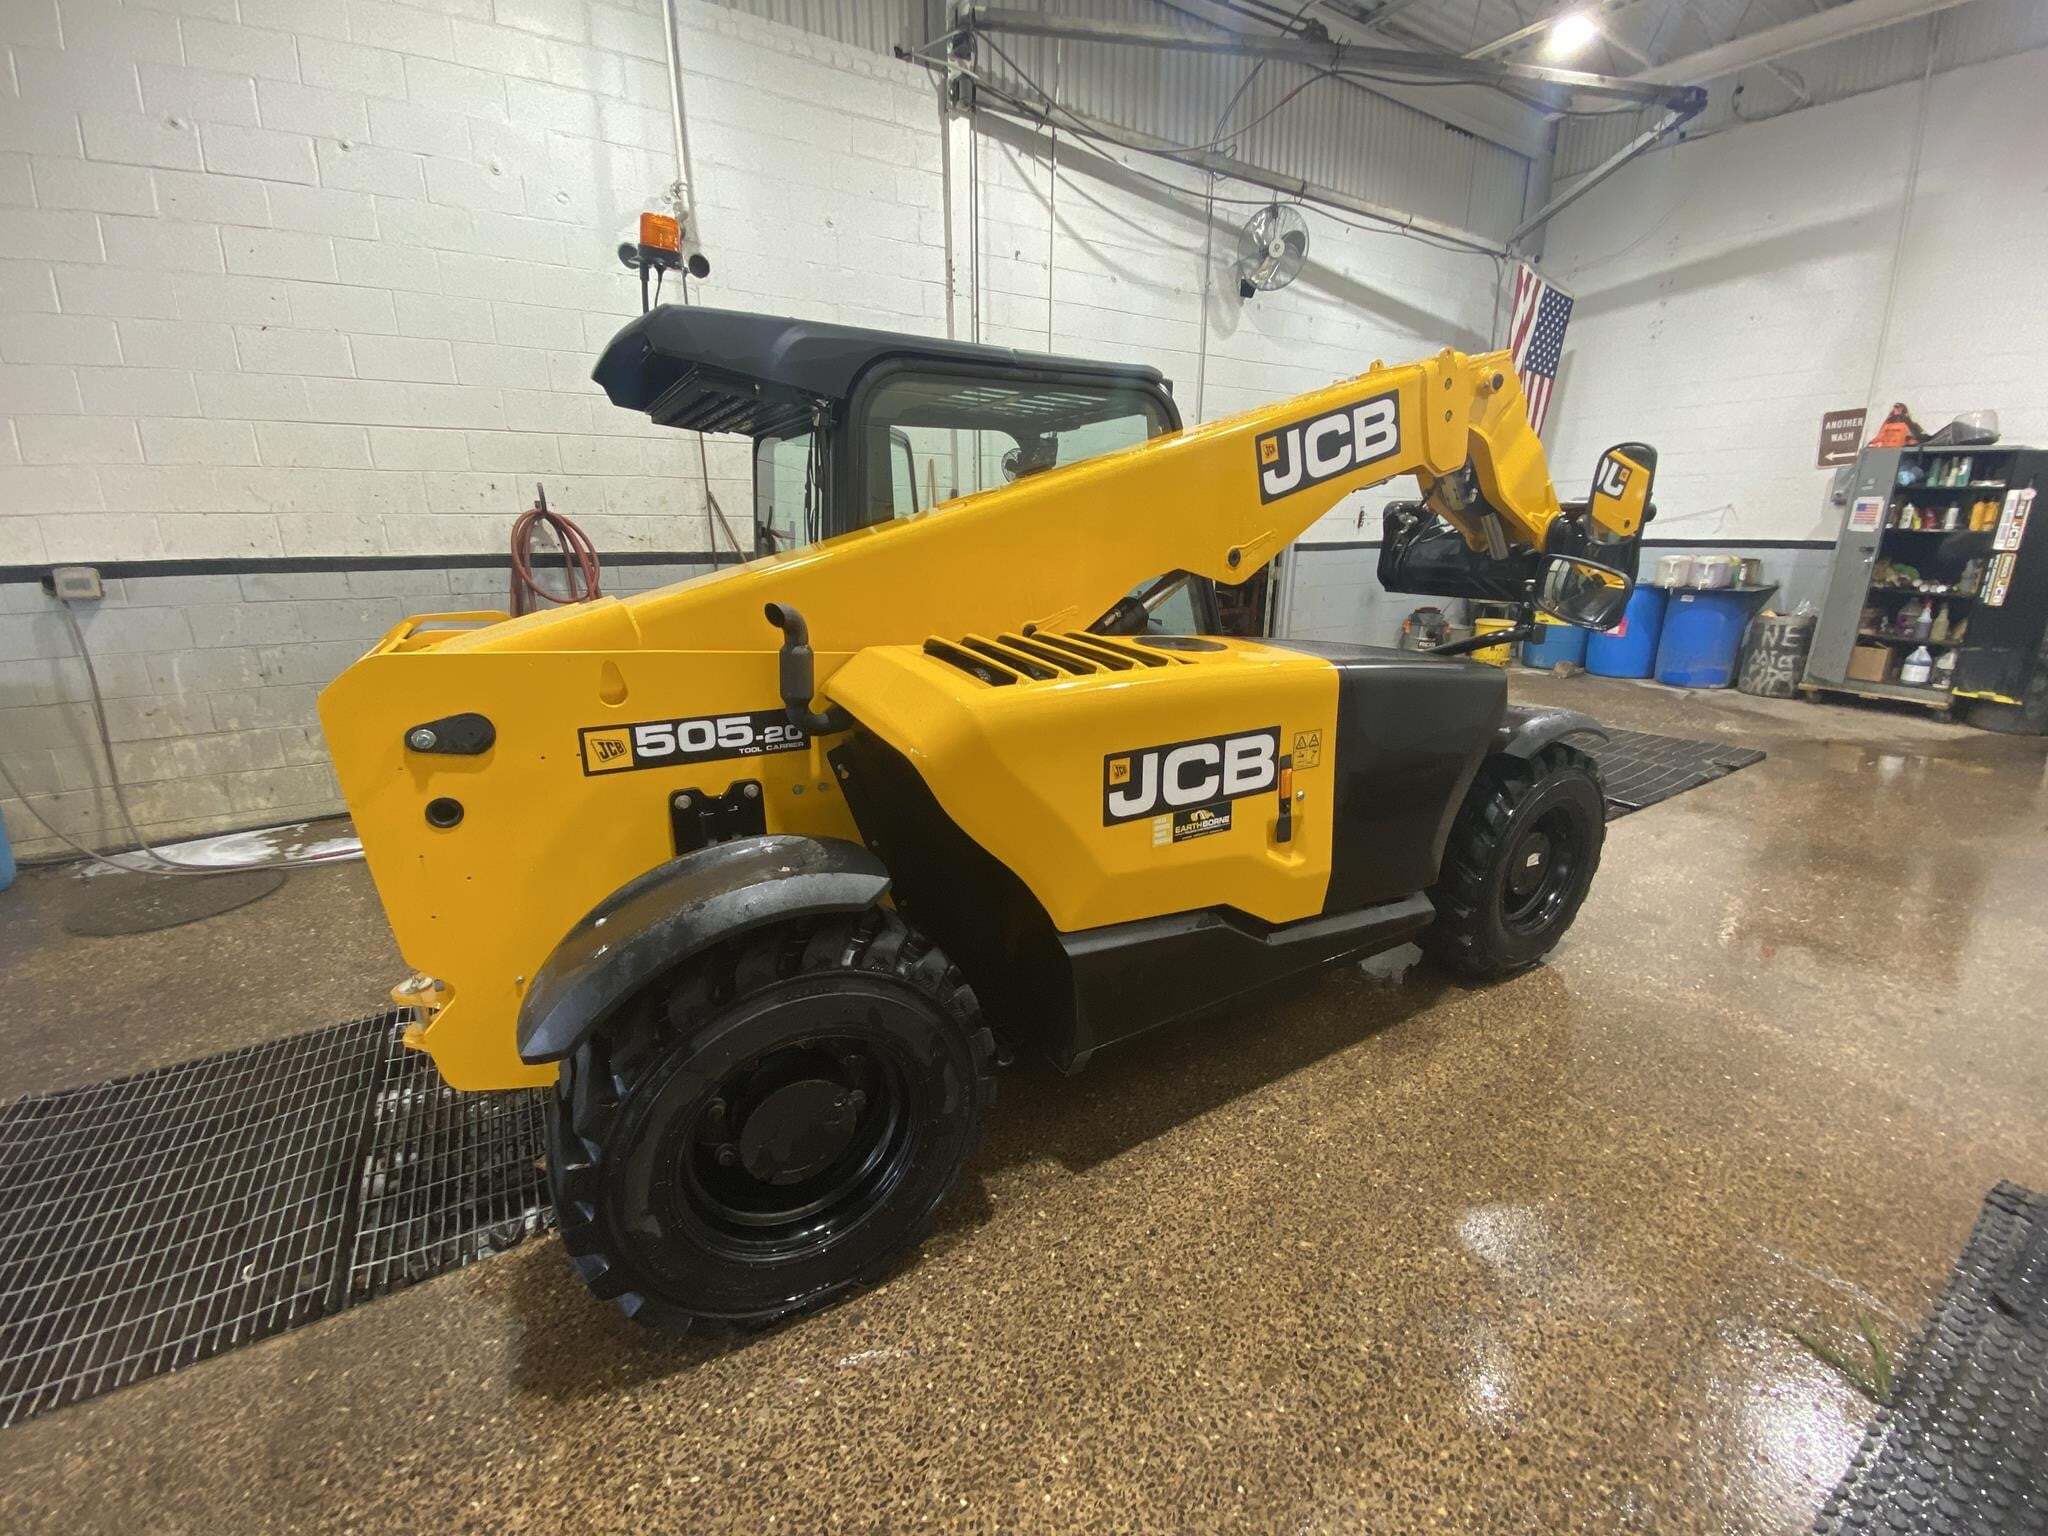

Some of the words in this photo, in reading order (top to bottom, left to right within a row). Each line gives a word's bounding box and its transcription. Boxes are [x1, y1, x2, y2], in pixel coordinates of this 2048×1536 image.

[1825, 418, 1864, 430] ANOTHER
[1263, 398, 1398, 496] JCB
[1831, 432, 1854, 442] WASH
[635, 716, 803, 757] 505-20
[597, 740, 626, 760] JCB
[738, 746, 762, 755] TOOL
[766, 741, 805, 752] CARRIER
[1109, 734, 1275, 817] JCB
